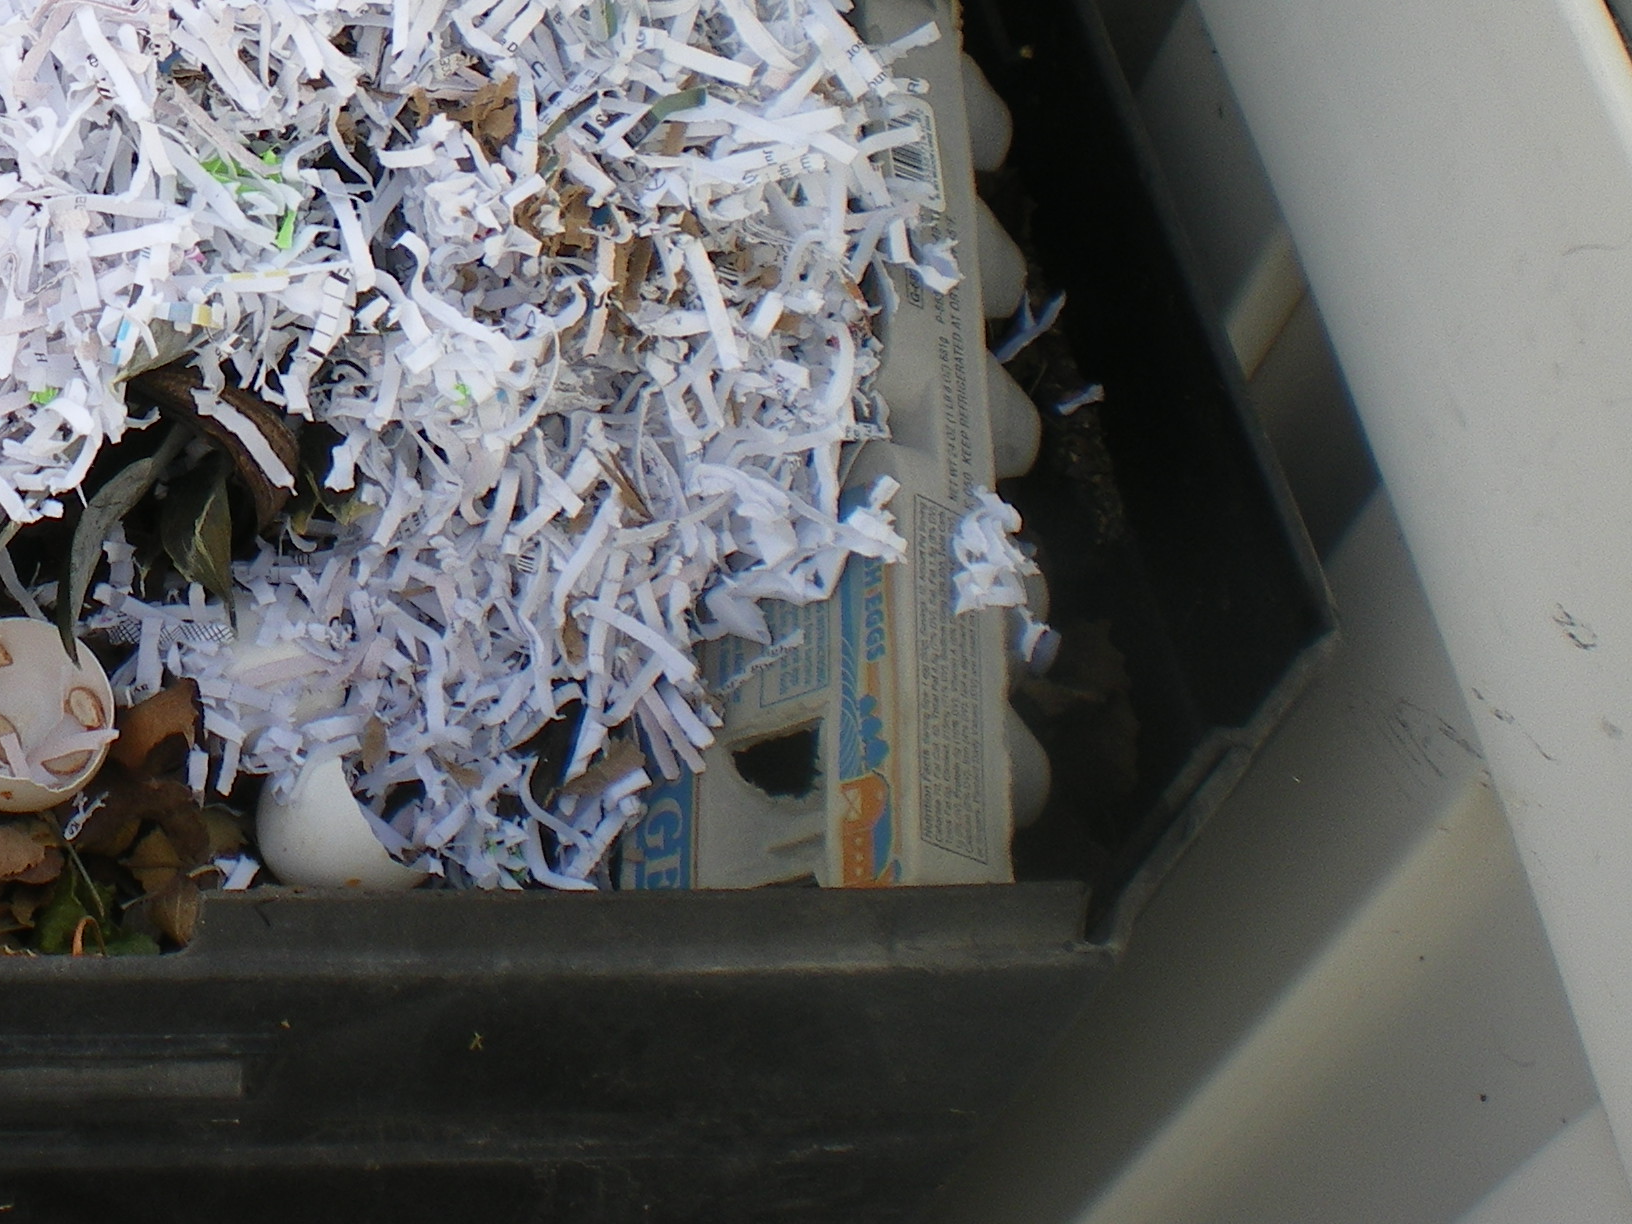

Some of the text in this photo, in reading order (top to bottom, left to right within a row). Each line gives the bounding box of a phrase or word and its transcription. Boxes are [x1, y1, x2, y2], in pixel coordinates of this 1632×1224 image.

[952, 331, 970, 428] REFRIGERATED
[960, 429, 973, 466] KEEP
[864, 591, 885, 662] EGGS
